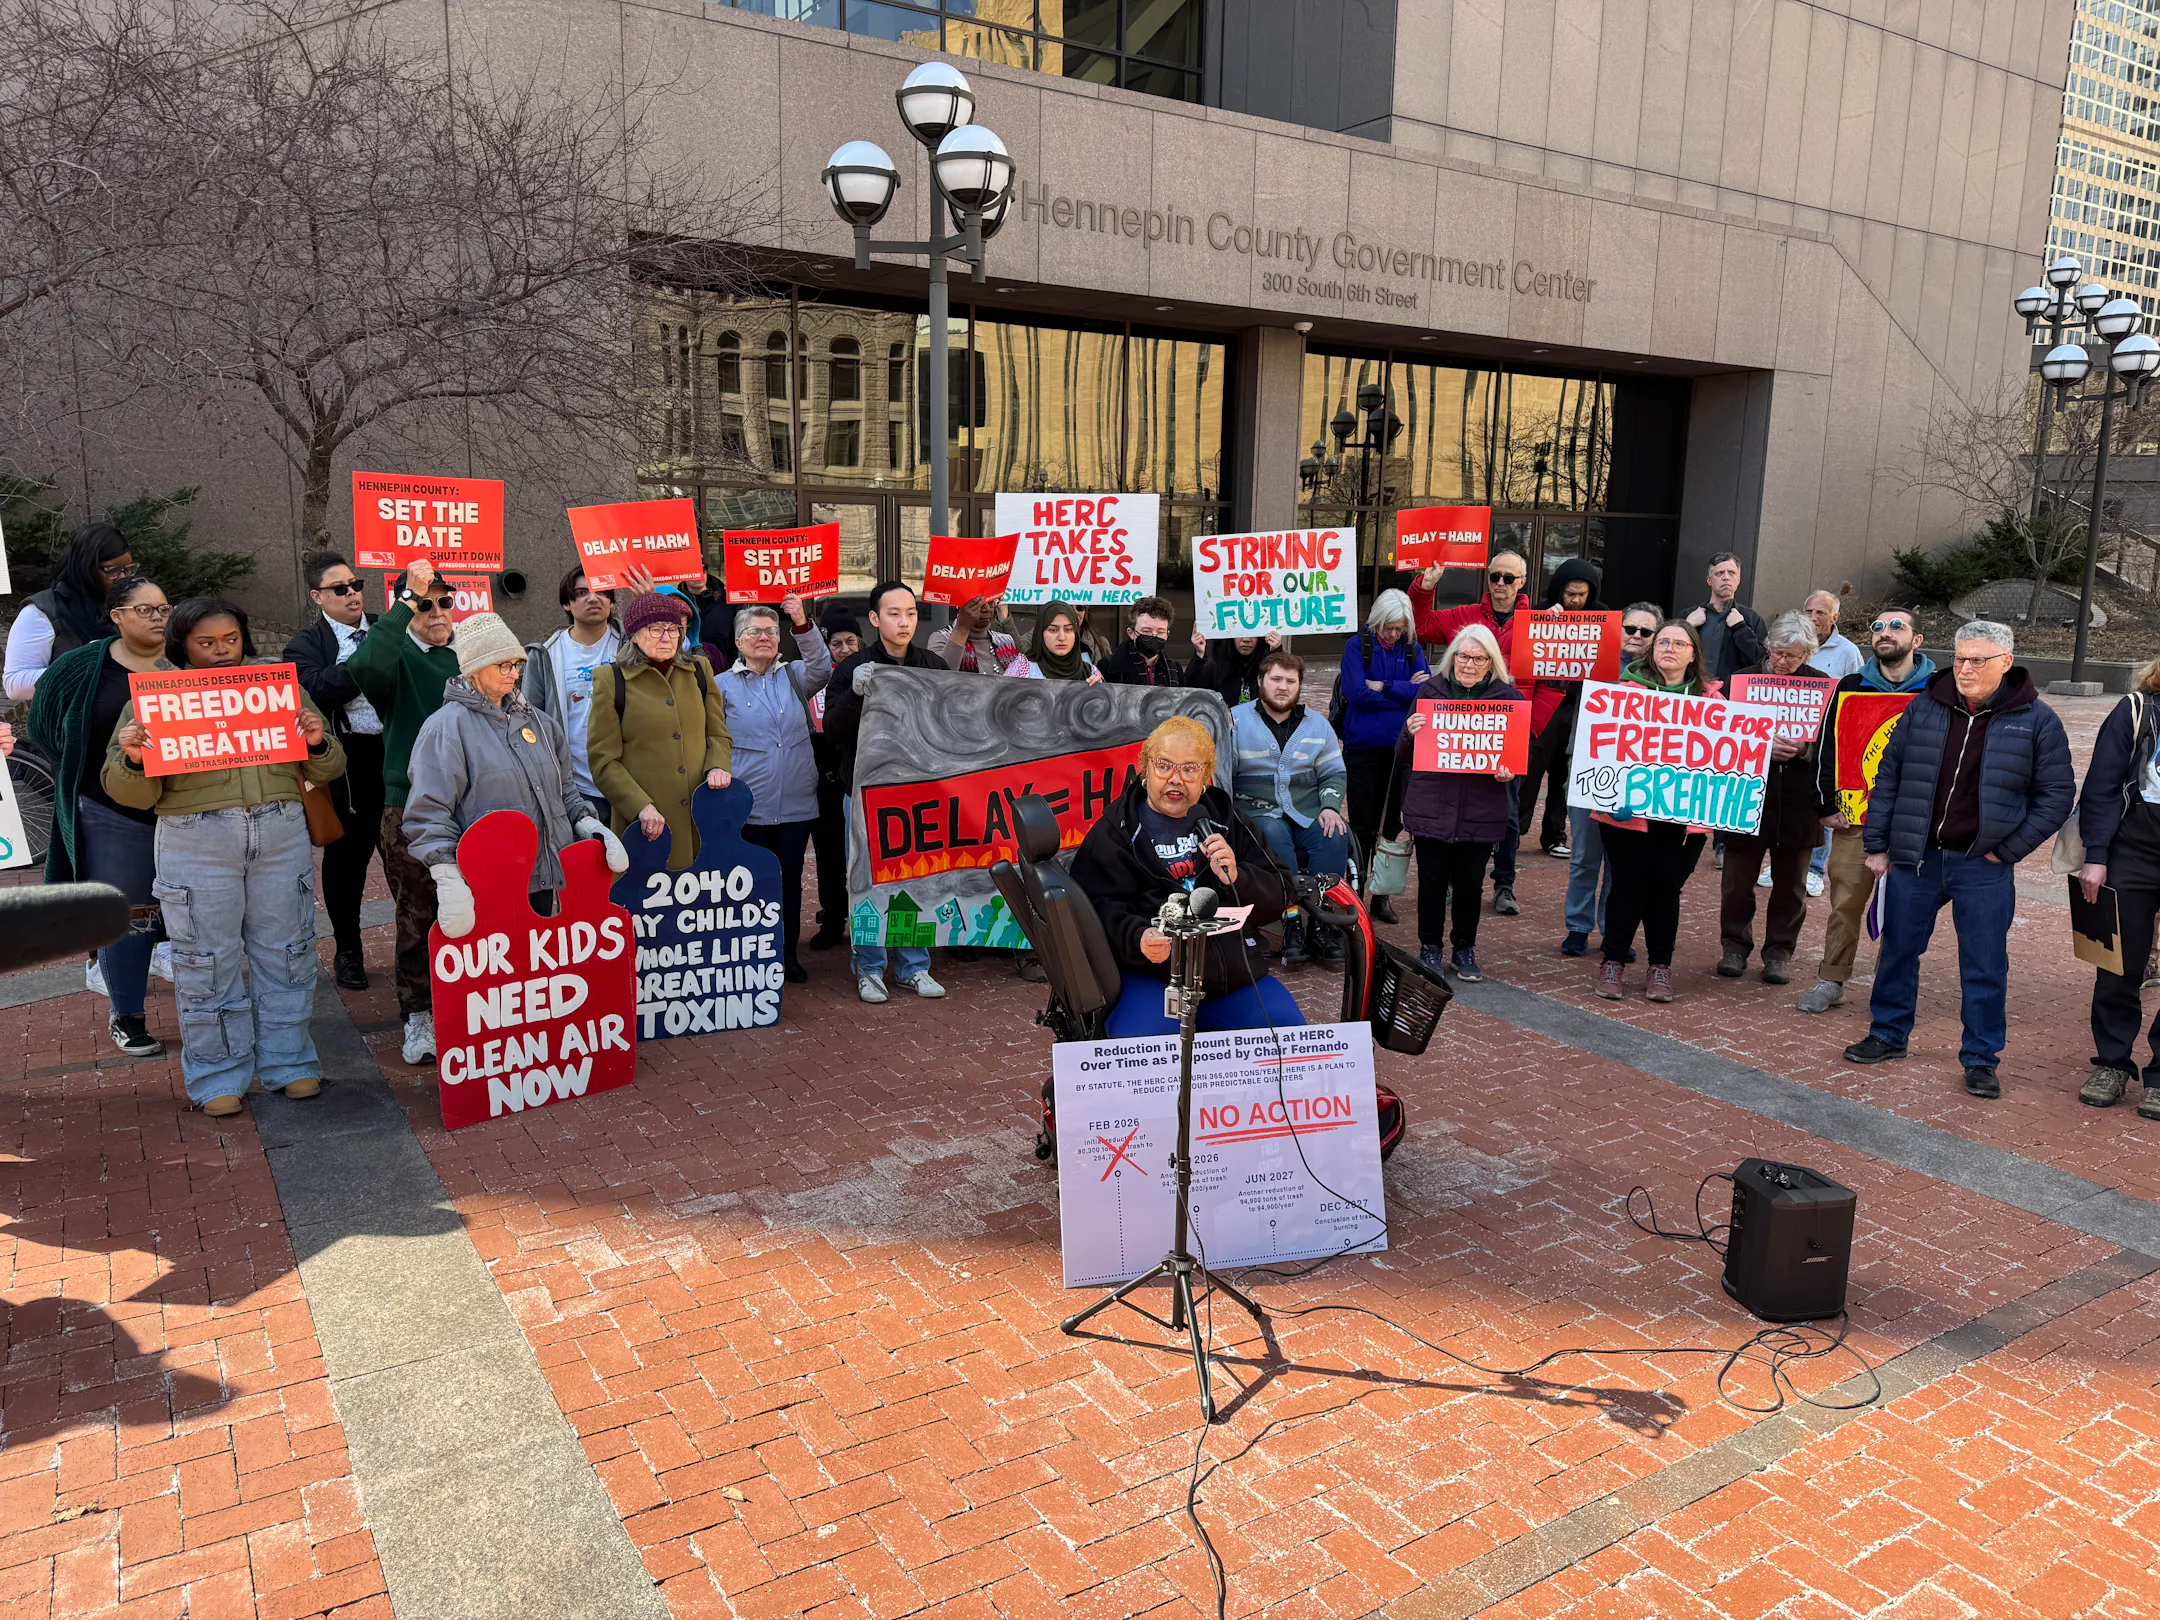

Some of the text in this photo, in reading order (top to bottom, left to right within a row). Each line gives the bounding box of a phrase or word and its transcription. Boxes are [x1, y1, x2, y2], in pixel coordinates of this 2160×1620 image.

[1022, 180, 1597, 302] Hennepin County Government Center
[1263, 272, 1418, 310] 300 South 6th Street
[358, 481, 460, 496] HENNEPIN COUNTY:
[378, 498, 479, 524] SET THE
[1033, 496, 1120, 528] HERC
[396, 524, 462, 548] DATE
[582, 538, 628, 556] DELAY
[644, 533, 690, 550] HARM
[772, 534, 808, 544] COUNTY:
[1025, 528, 1128, 556] TAKES
[1402, 531, 1437, 545] DELAY
[1448, 530, 1482, 542] HARM
[430, 552, 500, 561] SHUT IT DOWN
[744, 544, 822, 566] SET THE
[1199, 531, 1342, 572] STRIKING
[760, 566, 810, 586] DATE
[932, 564, 976, 580] DELAY
[985, 560, 1010, 578] HARM
[1035, 555, 1141, 586] LIVES.
[786, 586, 806, 594] SHUT
[816, 579, 836, 588] DOWN
[1223, 570, 1328, 597] FOR OUR
[1002, 588, 1044, 602] SHUT
[1052, 588, 1092, 602] DOWN
[1102, 589, 1143, 603] HERC
[1216, 594, 1346, 630] FUTURE
[1530, 614, 1568, 622] IGNORED
[1584, 614, 1608, 622] MORE
[1528, 624, 1602, 640] HUNGER
[1532, 642, 1598, 660] STRIKE
[1532, 660, 1595, 678] READY
[136, 670, 291, 691] MINNEAPOLIS DESERVES THE
[1748, 678, 1787, 686] IGNORED
[1804, 680, 1830, 688] MORE
[138, 684, 295, 724] FREEDOM
[1746, 686, 1824, 705] HUNGER
[1434, 703, 1472, 712] IGNORED
[1584, 688, 1774, 741] STRIKING FOR
[1778, 706, 1820, 722] RIKE
[215, 720, 227, 730] TO
[1432, 712, 1508, 731] HUNGER
[1778, 724, 1818, 738] ADY
[159, 726, 288, 762] BREATHE
[1436, 732, 1504, 750] STRIKE
[1590, 722, 1768, 774] FREEDOM
[1438, 752, 1502, 770] READY
[1864, 742, 1882, 762] THE
[184, 761, 200, 770] END
[201, 758, 228, 768] TRASH
[1576, 766, 1761, 828] TO BREATHE
[877, 783, 1034, 860] DELAY
[643, 865, 754, 909] 2040
[676, 899, 780, 934] CHILD'S
[435, 916, 625, 983] OUR KIDS
[712, 933, 776, 964] LIFE
[466, 973, 588, 1036] NEED
[636, 990, 780, 1038] TOXINS
[441, 1014, 630, 1085] CLEAN AIR
[1094, 1030, 1334, 1058] Reduction in mount Burned at HERC
[1080, 1041, 1349, 1072] Over Time as Pposed by Chair Fernando
[488, 1057, 593, 1117] NOW
[1088, 1081, 1125, 1090] STATUTE,
[1210, 1072, 1238, 1080] 365,000
[1134, 1086, 1164, 1095] REDUCE
[1210, 1078, 1262, 1088] PREDICTABLE
[1264, 1074, 1304, 1084] QUARTERS
[1200, 1095, 1350, 1130] NO ACTION
[1089, 1118, 1140, 1131] FEB 2026
[1194, 1154, 1219, 1164] 2026
[1246, 1171, 1294, 1184] JUN 2027
[1320, 1202, 1341, 1212] DEC
[1314, 1216, 1350, 1224] Conclusion
